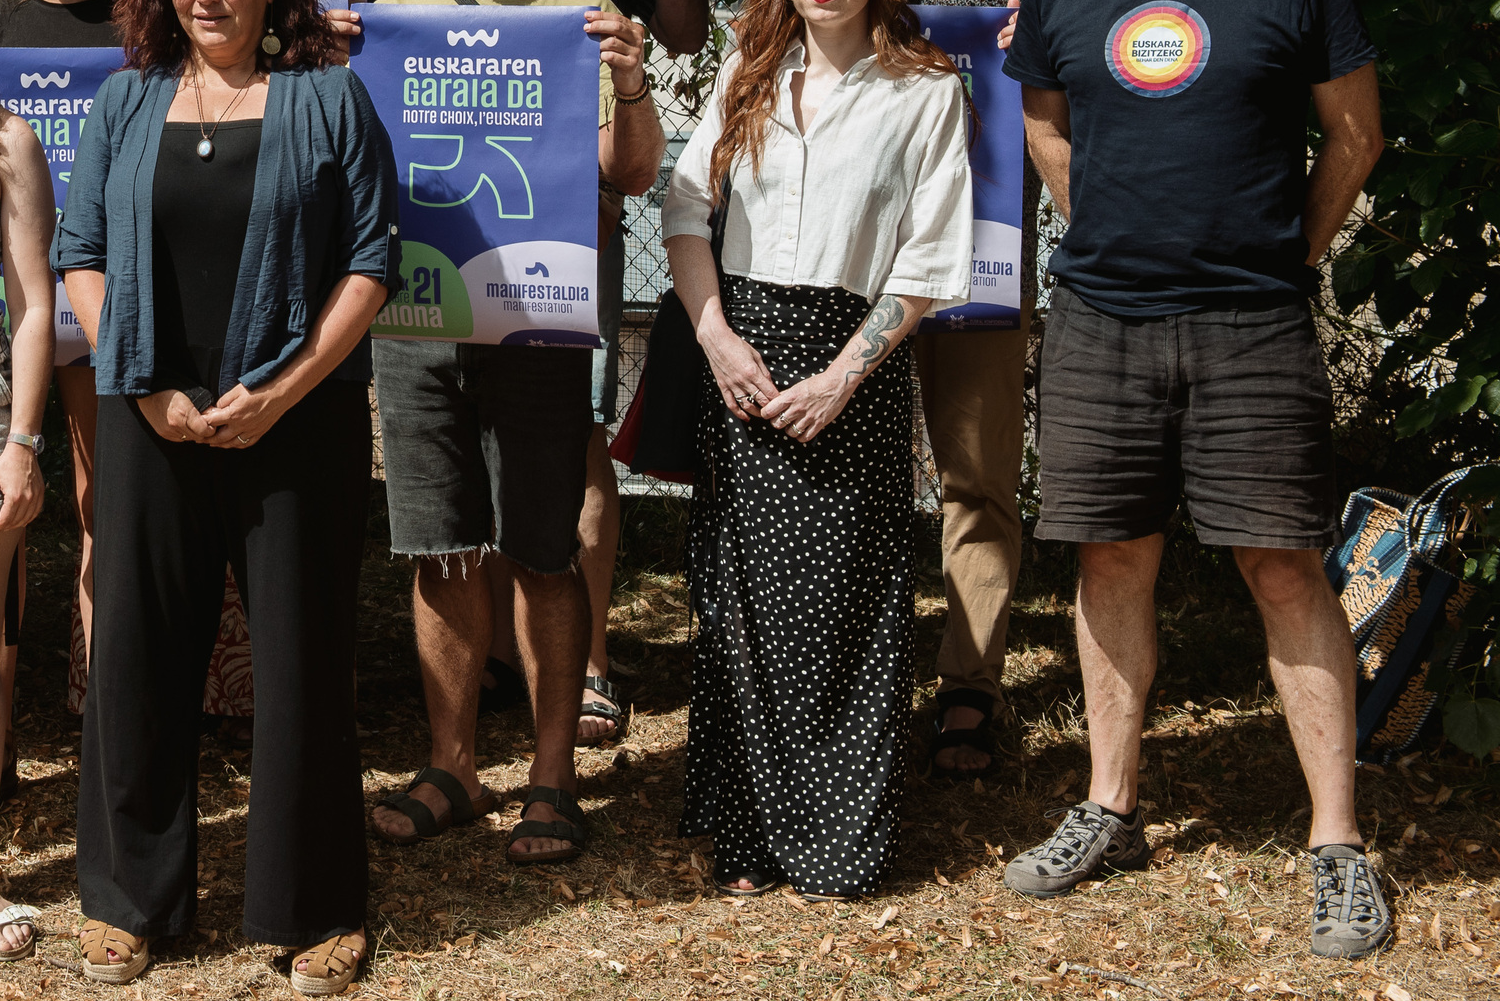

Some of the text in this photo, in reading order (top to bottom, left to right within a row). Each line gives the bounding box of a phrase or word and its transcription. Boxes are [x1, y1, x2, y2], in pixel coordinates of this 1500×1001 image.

[1132, 40, 1184, 48] EUSKARAZ
[1132, 49, 1183, 57] BIZITZEKO
[404, 56, 542, 76] euskararen
[403, 109, 437, 124] notre
[414, 266, 442, 304] 21
[372, 304, 444, 328] aiona
